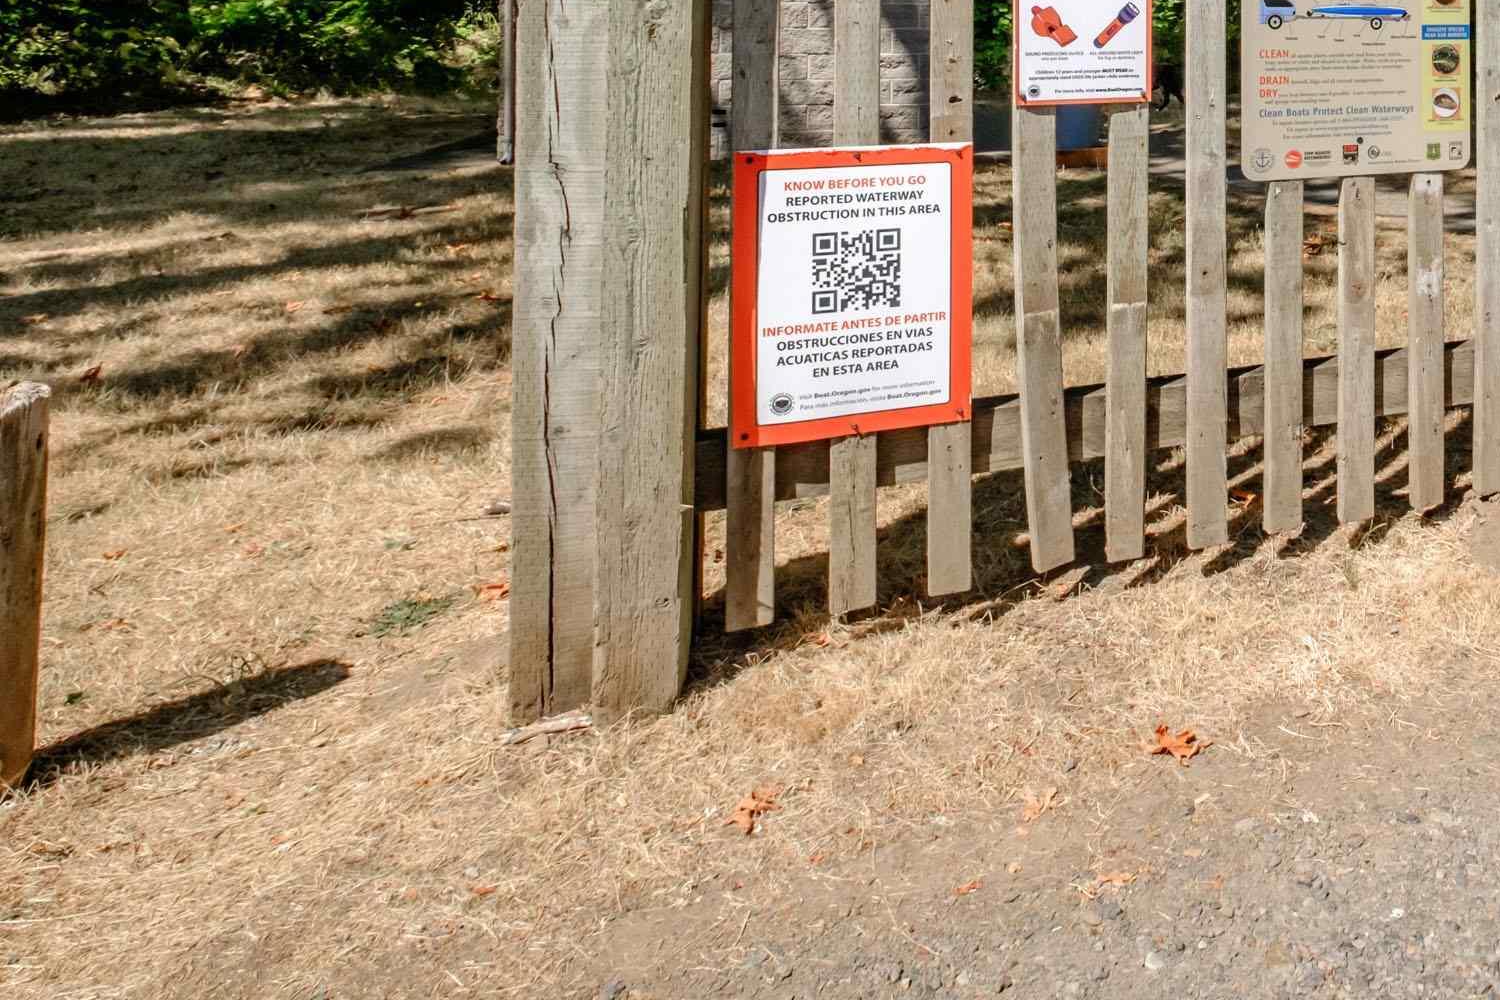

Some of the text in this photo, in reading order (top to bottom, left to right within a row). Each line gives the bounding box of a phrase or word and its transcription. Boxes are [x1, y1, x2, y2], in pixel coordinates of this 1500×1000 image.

[1259, 49, 1289, 58] CLEAN
[1259, 76, 1289, 85] DRAIN
[1259, 104, 1414, 118] Clean Boats Protect Clean Waterways
[784, 175, 926, 192] KNOW BEFORE YOU GO
[786, 190, 924, 207] REPORTED WATERWAY
[767, 204, 941, 223] OBSTRUCTION IN THIS AREA
[763, 311, 946, 337] INFORMATE ANTES DE PARTIR
[776, 326, 933, 351] OBSTRUCCIONES EN VIAS
[776, 341, 933, 367] ACUATICAS REPORTADAS
[812, 359, 899, 378] EN ESTA AREA
